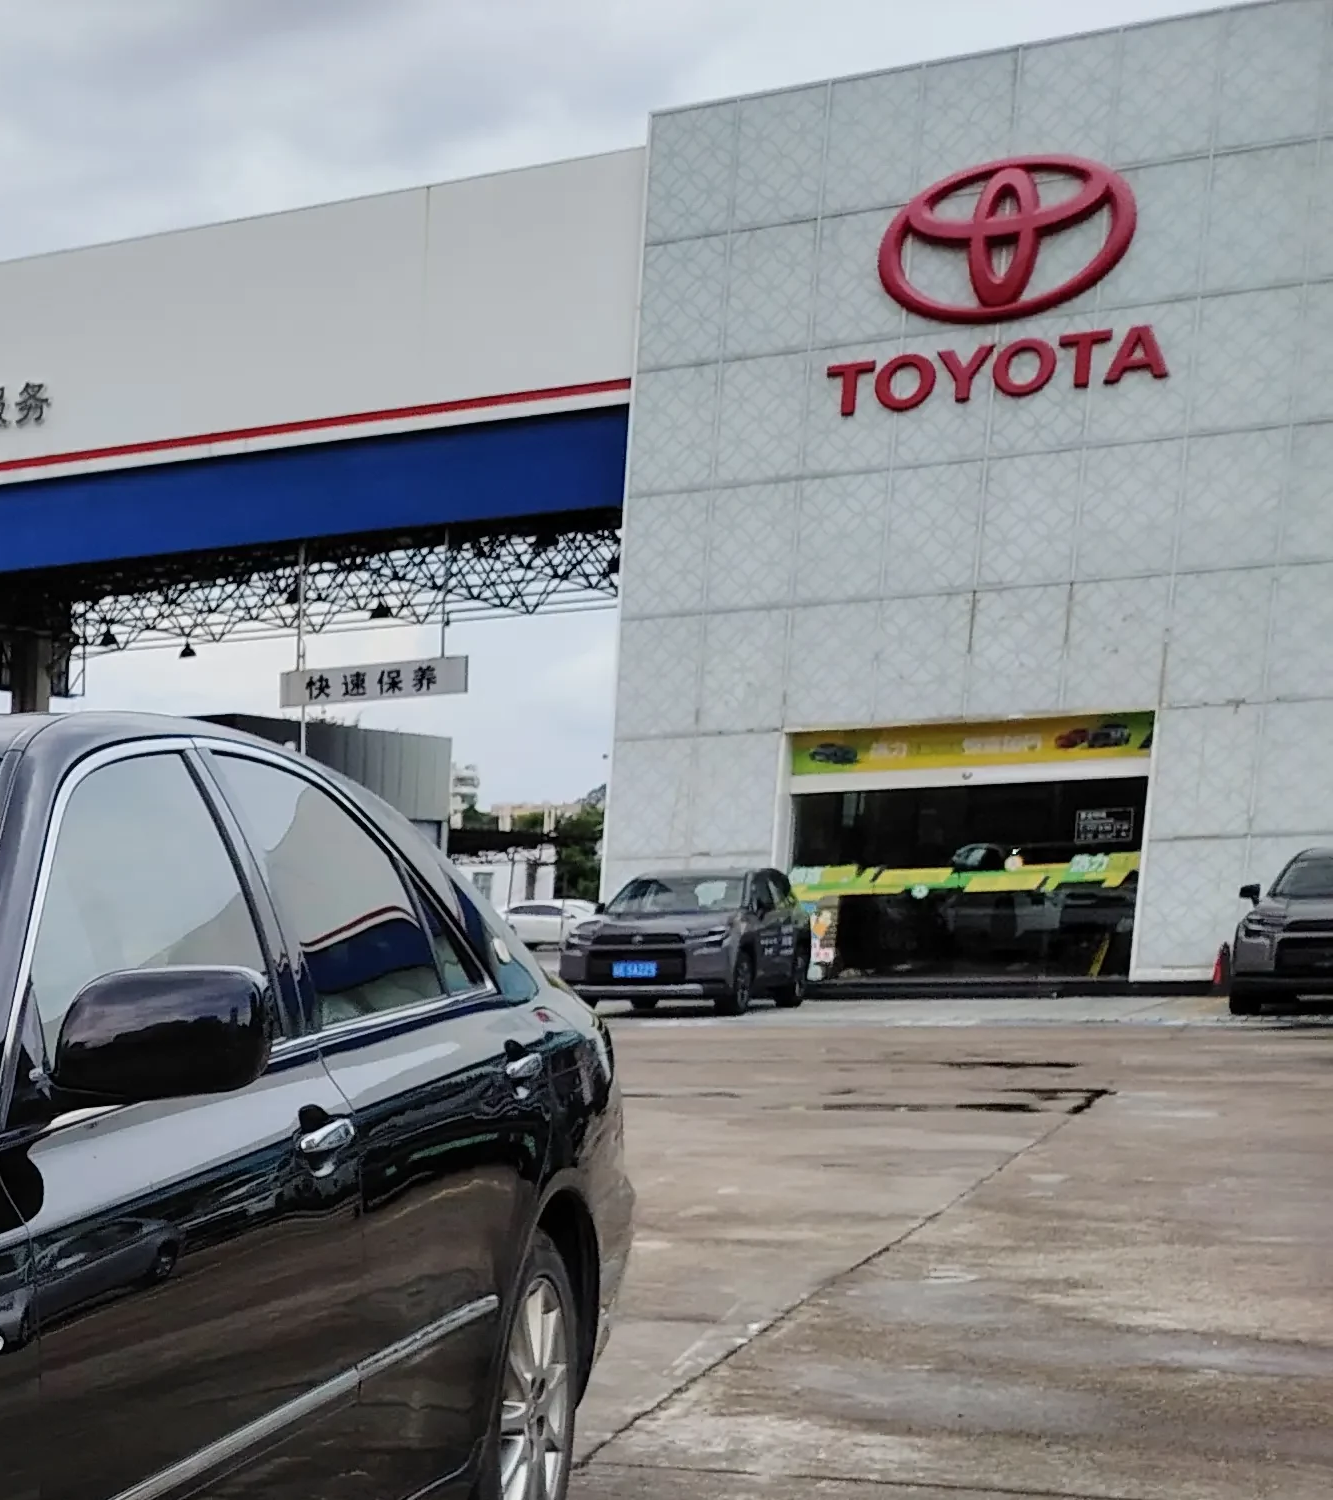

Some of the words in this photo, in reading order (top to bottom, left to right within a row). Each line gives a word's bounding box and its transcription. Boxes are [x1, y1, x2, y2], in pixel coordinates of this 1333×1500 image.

[826, 323, 1169, 417] TOYOTA
[305, 665, 438, 700] 快速保养
